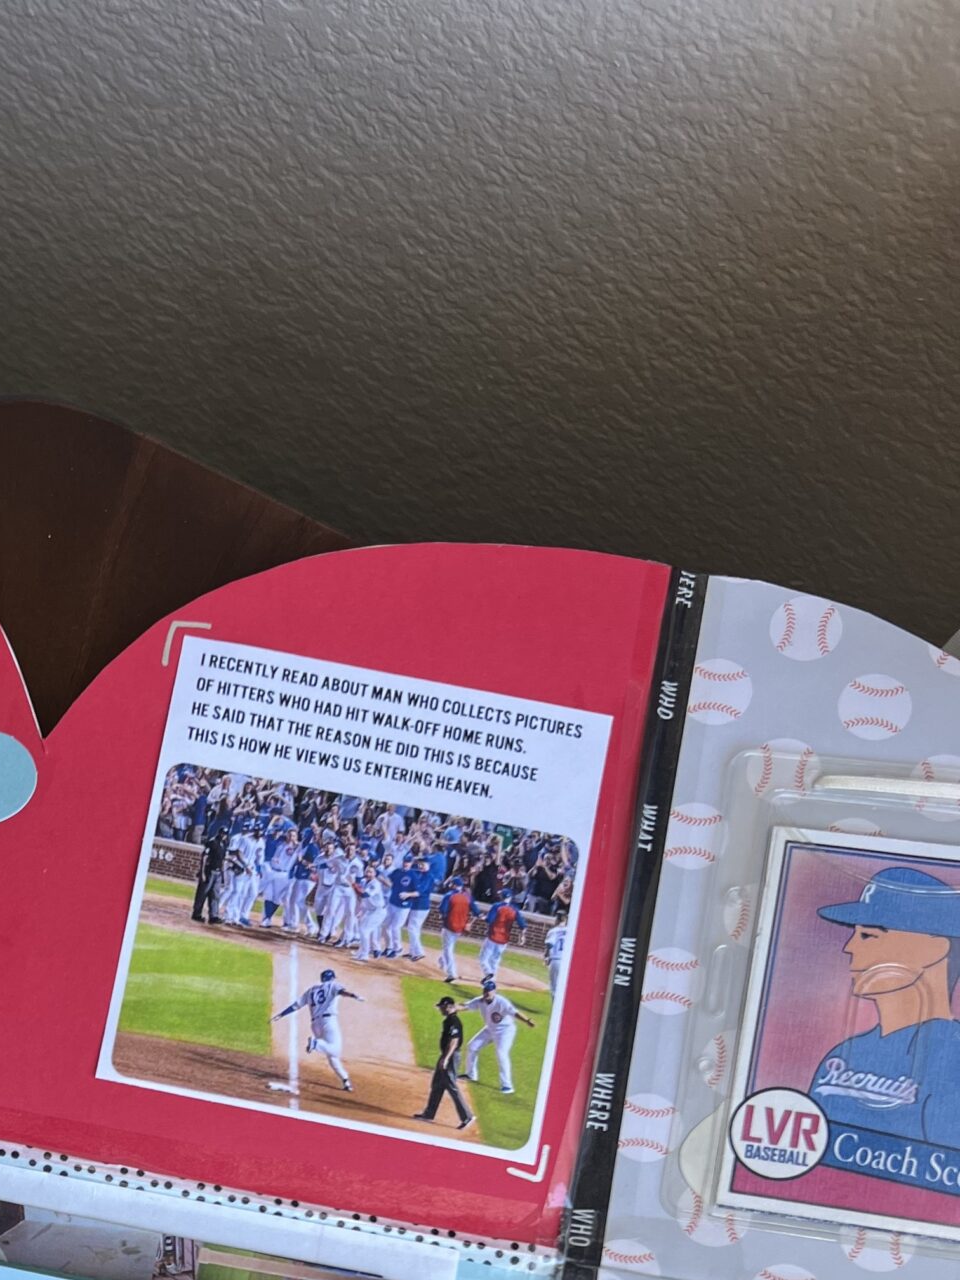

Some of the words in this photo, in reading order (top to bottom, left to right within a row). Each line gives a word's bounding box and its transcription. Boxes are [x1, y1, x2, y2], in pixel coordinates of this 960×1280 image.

[195, 676, 214, 692] OF
[216, 680, 275, 705] HITTERS
[278, 692, 311, 712] WHO
[312, 699, 342, 718] HAD
[344, 705, 369, 723] HIT
[372, 710, 441, 736] WALK-OFF
[441, 724, 482, 745] HOME
[484, 732, 526, 754] RUNS.
[200, 652, 206, 666] I
[208, 653, 279, 679] RECENTLY
[280, 667, 319, 687] READ
[320, 675, 369, 697] ABOUT
[370, 684, 403, 704] MAN
[406, 691, 439, 711] WHO
[441, 698, 512, 725] COLLECTS
[514, 712, 583, 739] PICTURES
[656, 680, 678, 720] WHO
[187, 725, 218, 745] THIS
[220, 732, 236, 749] IS
[237, 735, 272, 755] HOW
[272, 742, 292, 760] HE
[295, 747, 340, 769] VIEWS
[342, 756, 362, 773] US
[363, 760, 433, 787] ENTERING
[434, 774, 492, 798] HEAVEN.
[190, 700, 210, 717] HE
[211, 704, 246, 724] SAID
[249, 711, 284, 732] THAT
[287, 719, 313, 738] THE
[314, 725, 372, 749] REASON
[373, 736, 393, 754] HE
[394, 741, 420, 758] DID
[423, 746, 454, 766] THIS
[456, 753, 471, 769] IS
[473, 756, 538, 782] BECAUSE
[638, 803, 658, 852] WHAT
[613, 937, 637, 987] WHEN
[586, 1072, 616, 1132] WHERE
[817, 1057, 918, 1102] Recruits
[741, 1104, 821, 1153] LVR
[744, 1144, 809, 1168] BASEBALL
[833, 1133, 918, 1178] Coach
[925, 1152, 960, 1187] Sc
[568, 1209, 595, 1248] WHO
